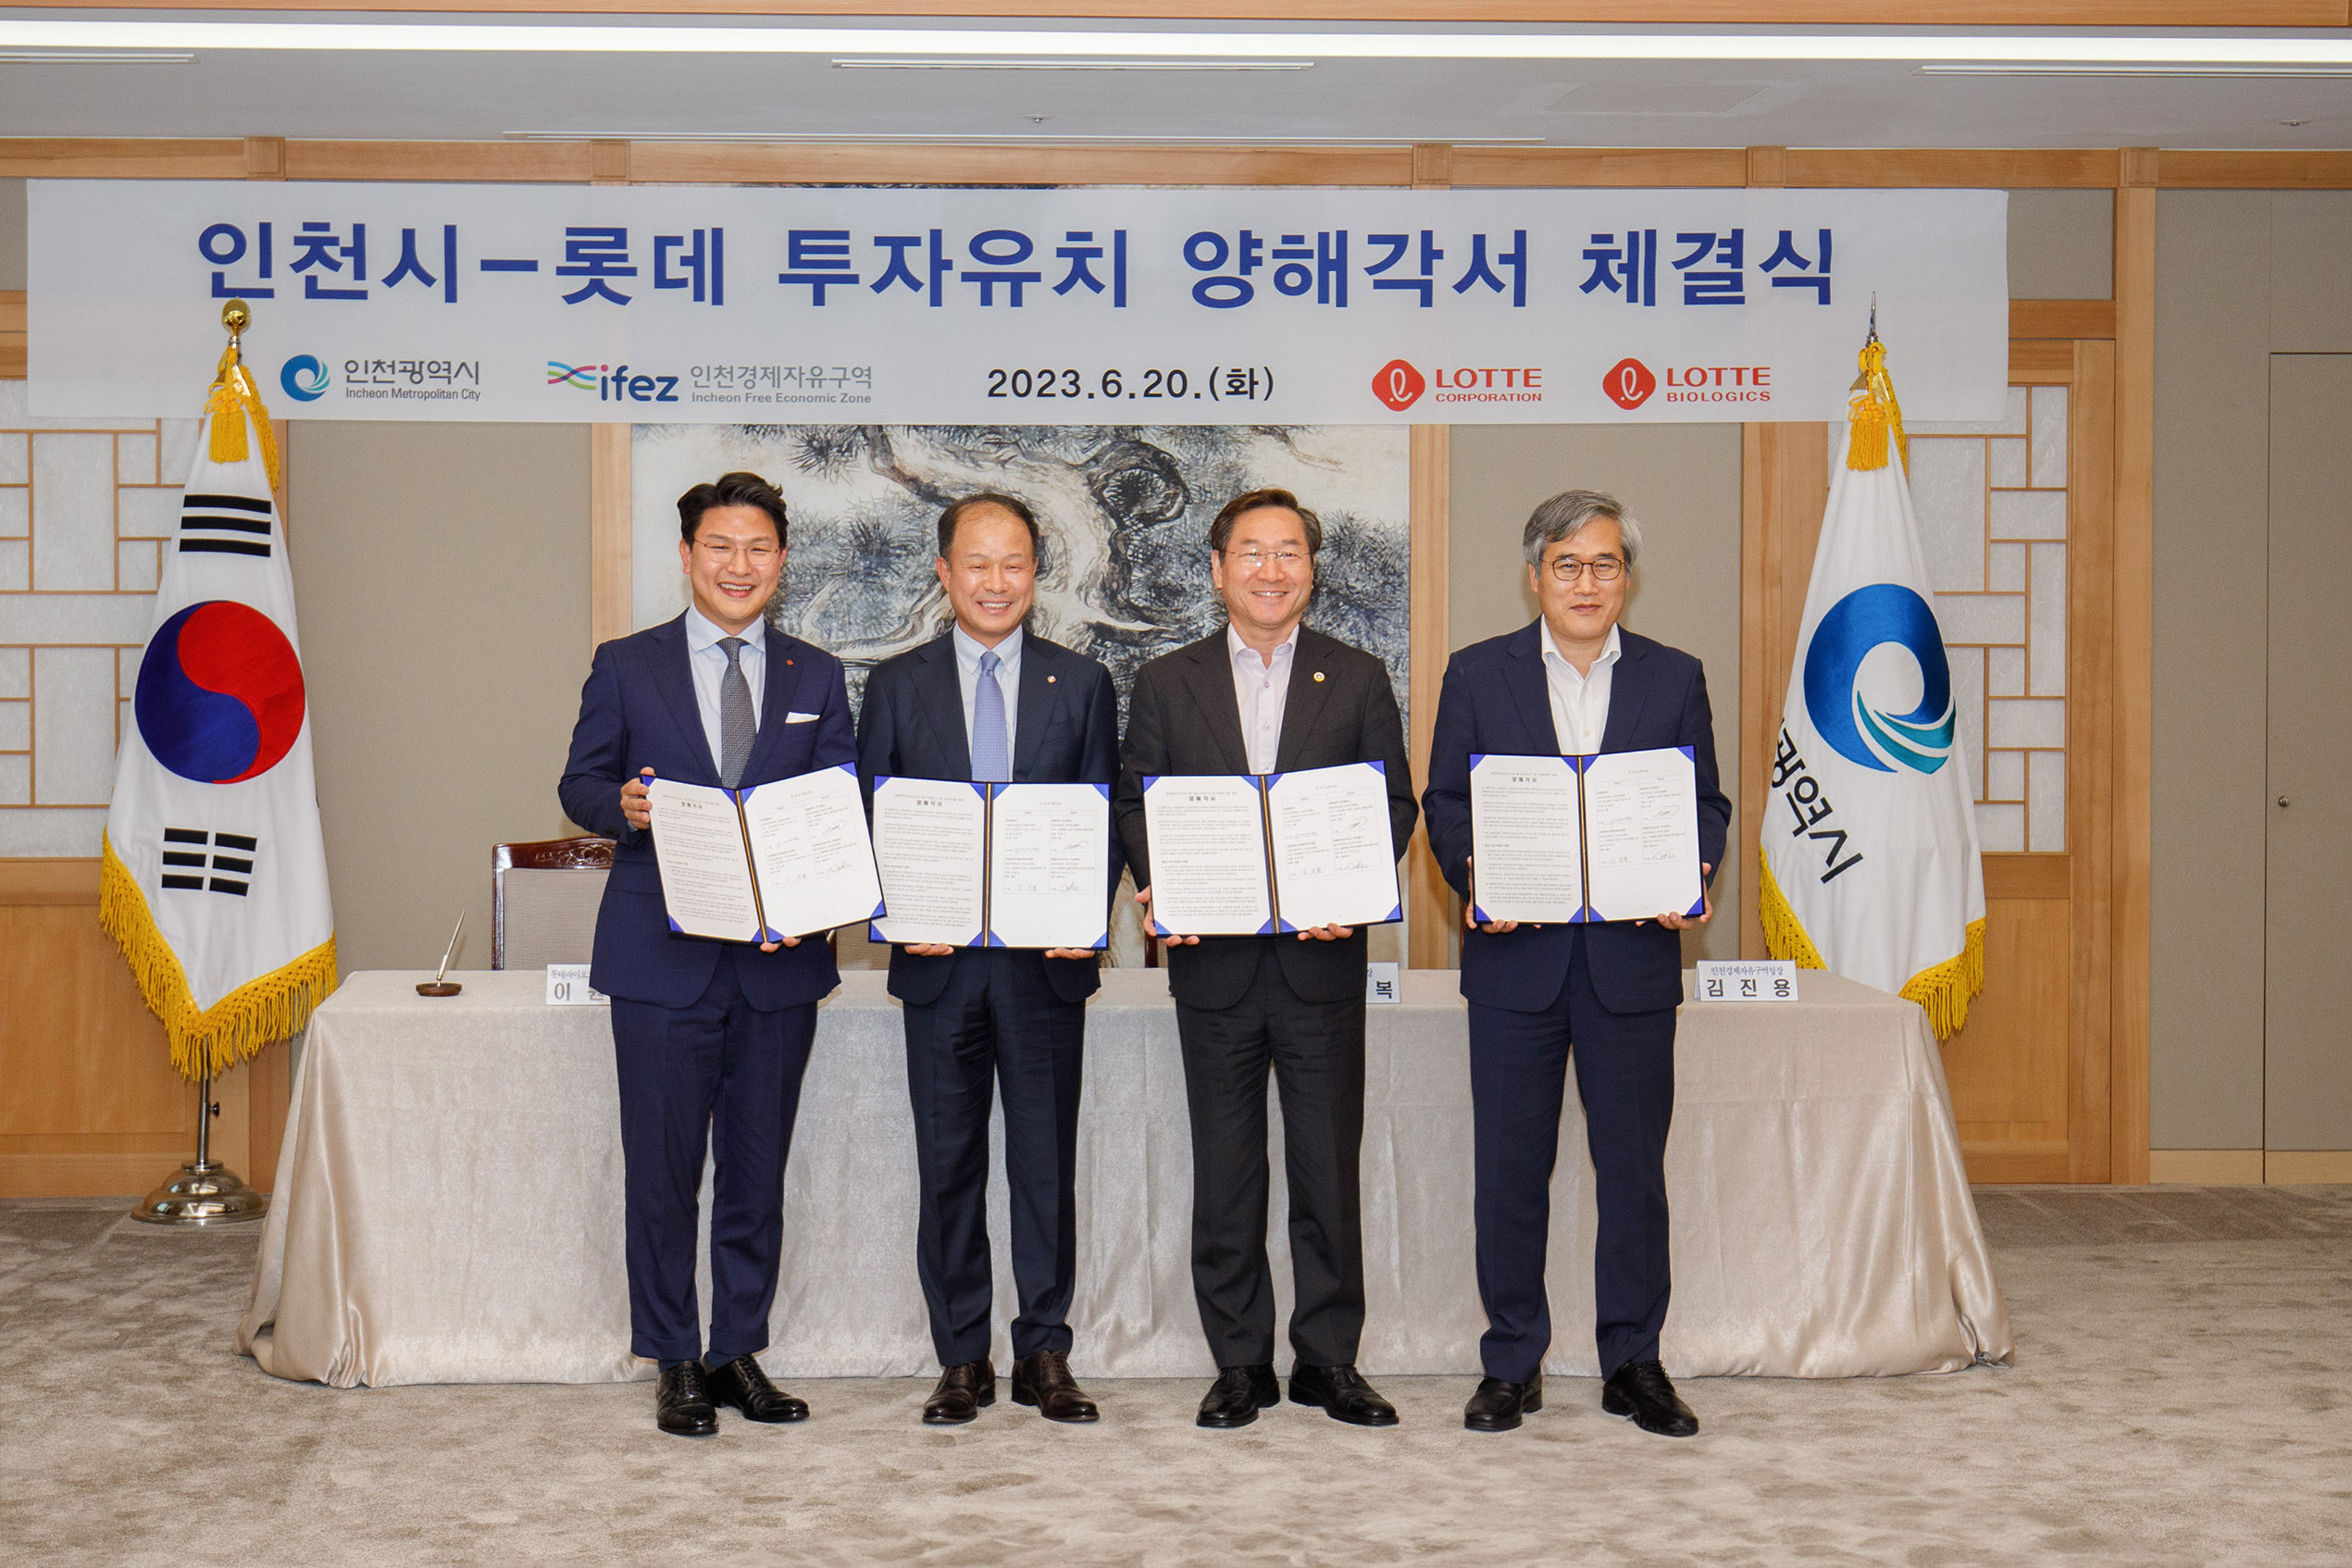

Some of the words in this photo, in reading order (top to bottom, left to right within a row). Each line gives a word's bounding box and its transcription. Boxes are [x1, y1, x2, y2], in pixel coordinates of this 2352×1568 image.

[778, 229, 1126, 307] 투자유치
[1184, 230, 1526, 308] 양해각서
[1579, 229, 1832, 306] 체결식
[344, 359, 479, 385] 인천광역시
[691, 366, 871, 389] 인천경제자유구역
[1436, 368, 1541, 389] LOTTE
[1667, 367, 1770, 388] LOTTE
[602, 365, 678, 402] ifez
[988, 367, 1273, 402] 2023.6.20.(화)
[345, 387, 389, 399] Incheon
[391, 387, 459, 402] Metropolitan
[461, 388, 480, 402] City
[692, 392, 740, 403] Incheon
[744, 392, 772, 403] Free
[776, 392, 836, 403] Economic
[840, 392, 871, 403] Zone
[1436, 392, 1541, 403] CORPORATION
[1667, 392, 1770, 402] BIOLOGICS
[1772, 718, 1863, 884] 광역시
[1375, 981, 1392, 999] 복
